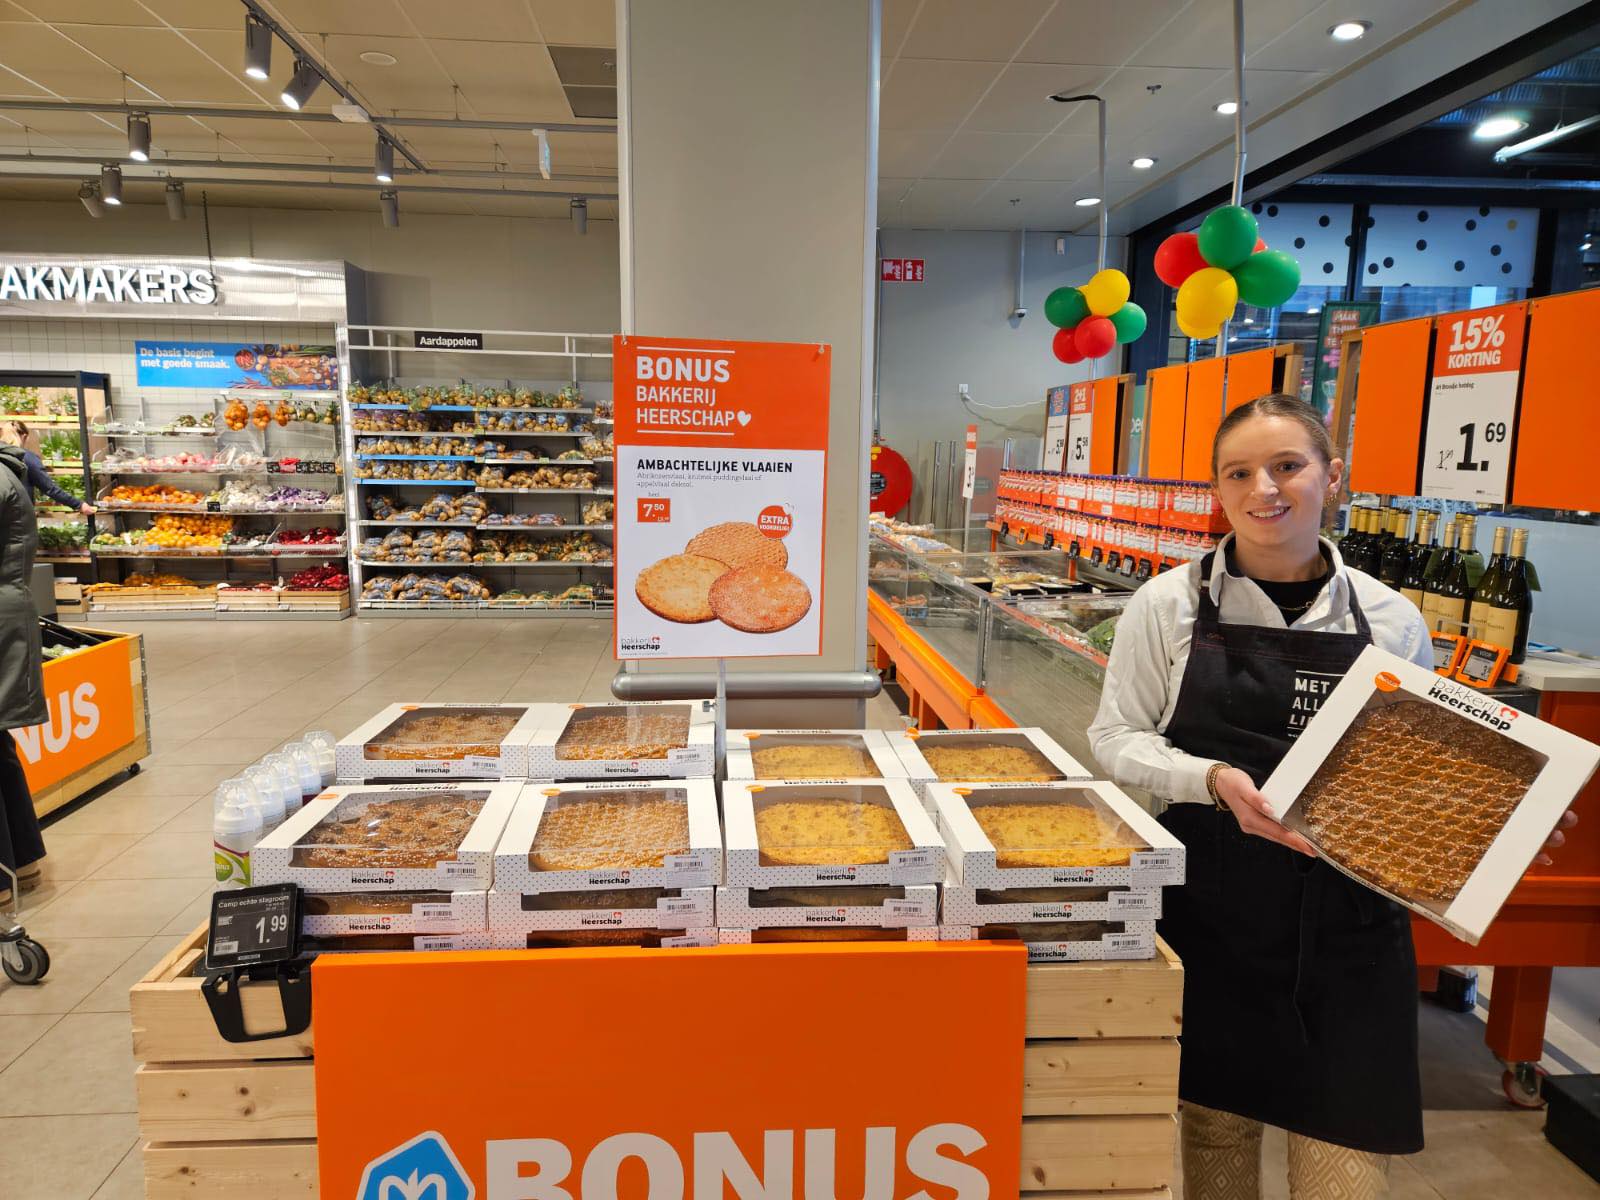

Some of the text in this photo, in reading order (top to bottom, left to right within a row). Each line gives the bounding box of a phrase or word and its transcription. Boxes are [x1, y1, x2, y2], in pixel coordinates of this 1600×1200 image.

[0, 265, 216, 304] AKMAKERS
[419, 336, 478, 347] Aardappelen
[1450, 315, 1505, 352] 15%
[140, 348, 215, 360] De basis begint
[1448, 350, 1501, 369] KORTING
[140, 360, 230, 369] met goede smaak.
[637, 356, 730, 382] BONUS
[636, 385, 716, 406] BAKKERIJ
[636, 407, 735, 427] HEERSCHAP
[1456, 422, 1507, 472] 1.69
[637, 459, 793, 473] AMBACHTELIJKE VLAAIEN
[643, 503, 665, 517] 7.50
[761, 515, 789, 525] EXTRA
[1295, 678, 1330, 694] MET
[1433, 677, 1499, 713] bakkerij
[1292, 696, 1320, 711] ALL
[1428, 688, 1512, 731] Heerschap
[589, 877, 630, 885] Heerschap
[218, 900, 239, 908] Camp
[256, 914, 288, 944] 1.99
[485, 1122, 990, 1200] BONUS
